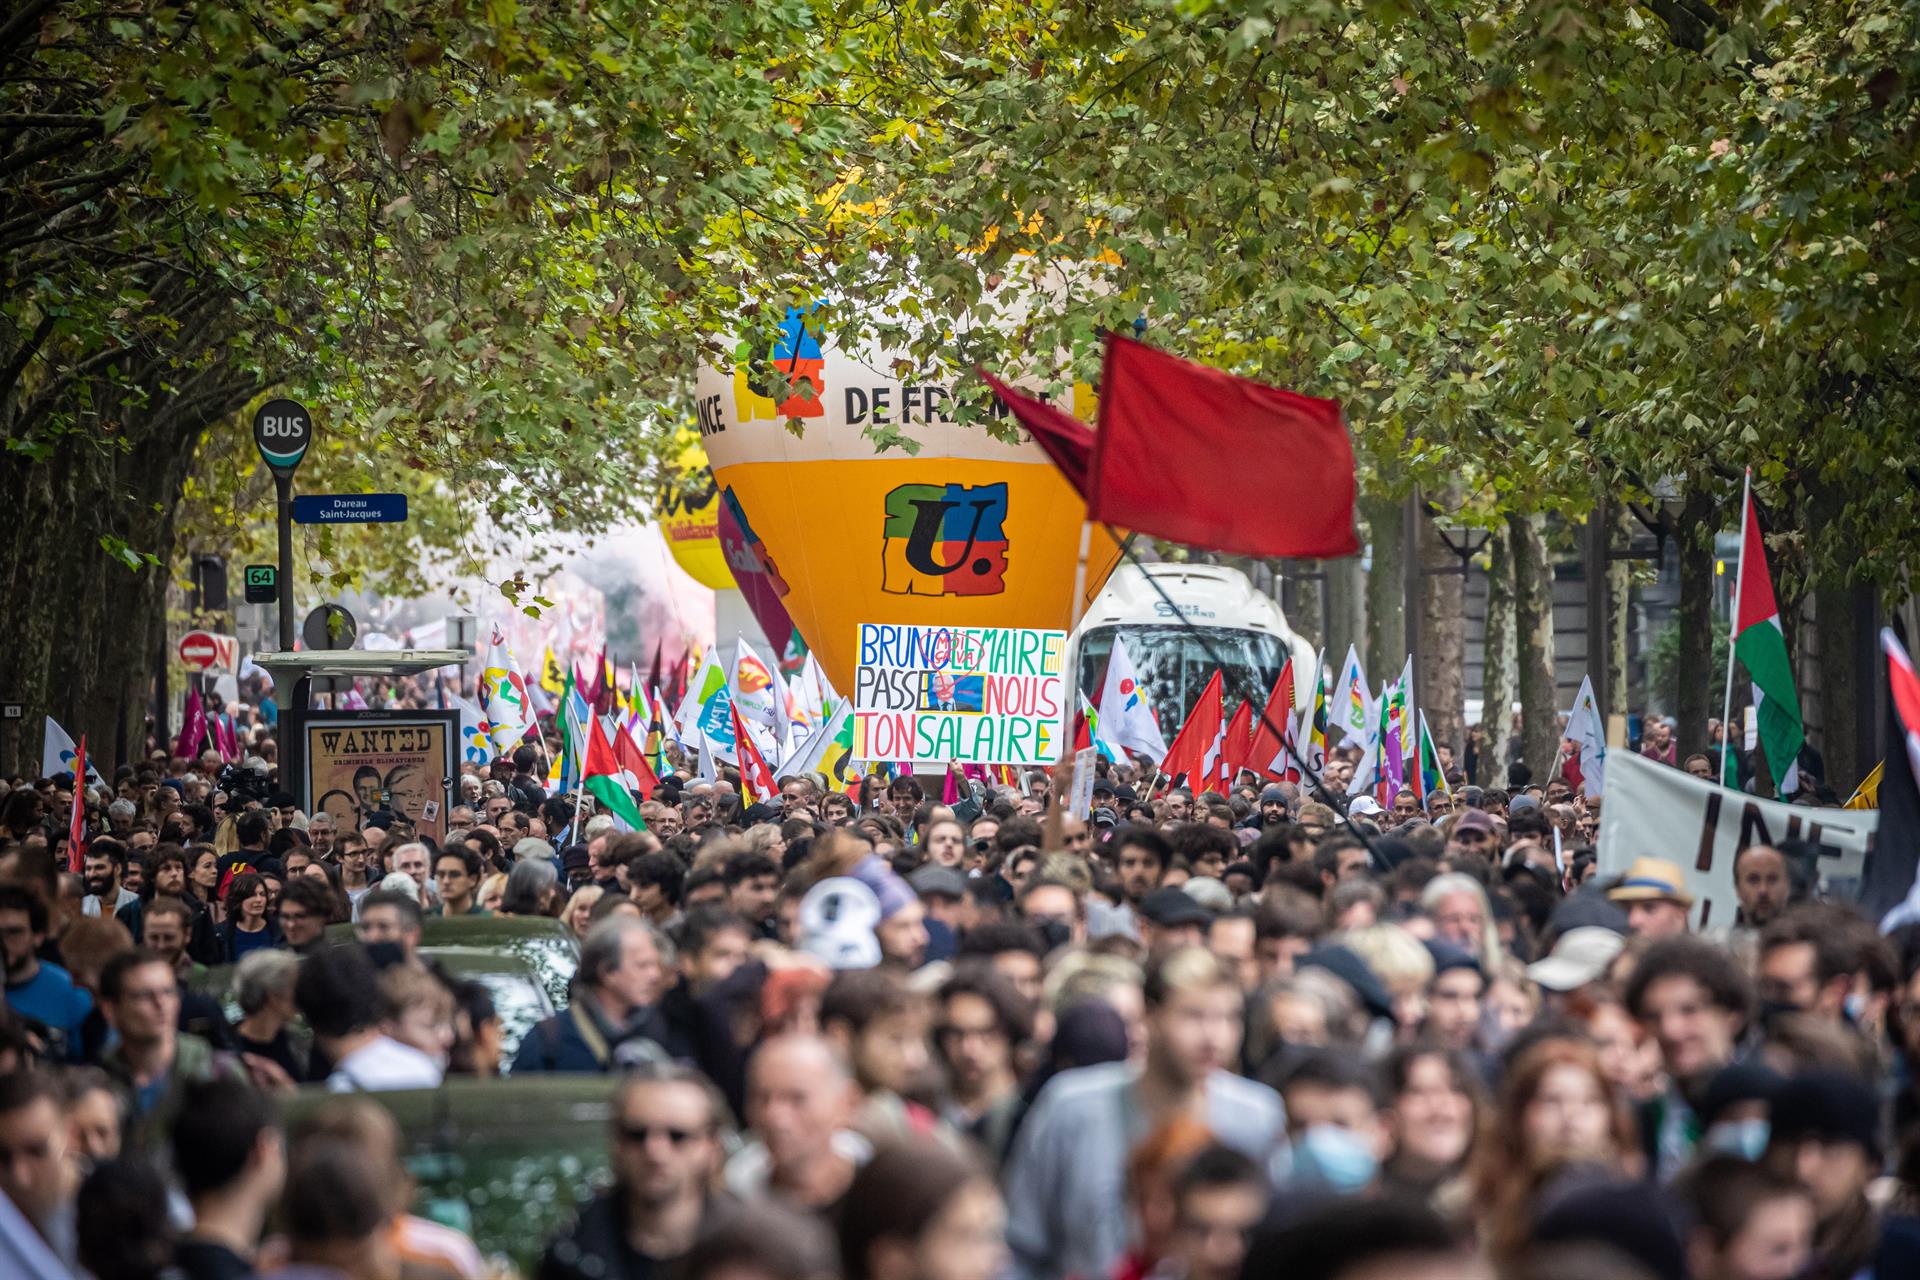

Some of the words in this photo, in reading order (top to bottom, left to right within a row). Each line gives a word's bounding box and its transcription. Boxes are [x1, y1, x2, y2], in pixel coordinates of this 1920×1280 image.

[845, 387, 891, 425] DE
[263, 416, 303, 437] BUS
[319, 510, 381, 519] Saint-Jacques
[334, 499, 367, 508] Dareau
[251, 570, 272, 584] 64
[861, 624, 951, 669] BRUNO
[857, 666, 937, 711] PASSE
[985, 675, 1060, 717] NOUS
[321, 729, 431, 755] WANTED
[855, 712, 916, 758] TON
